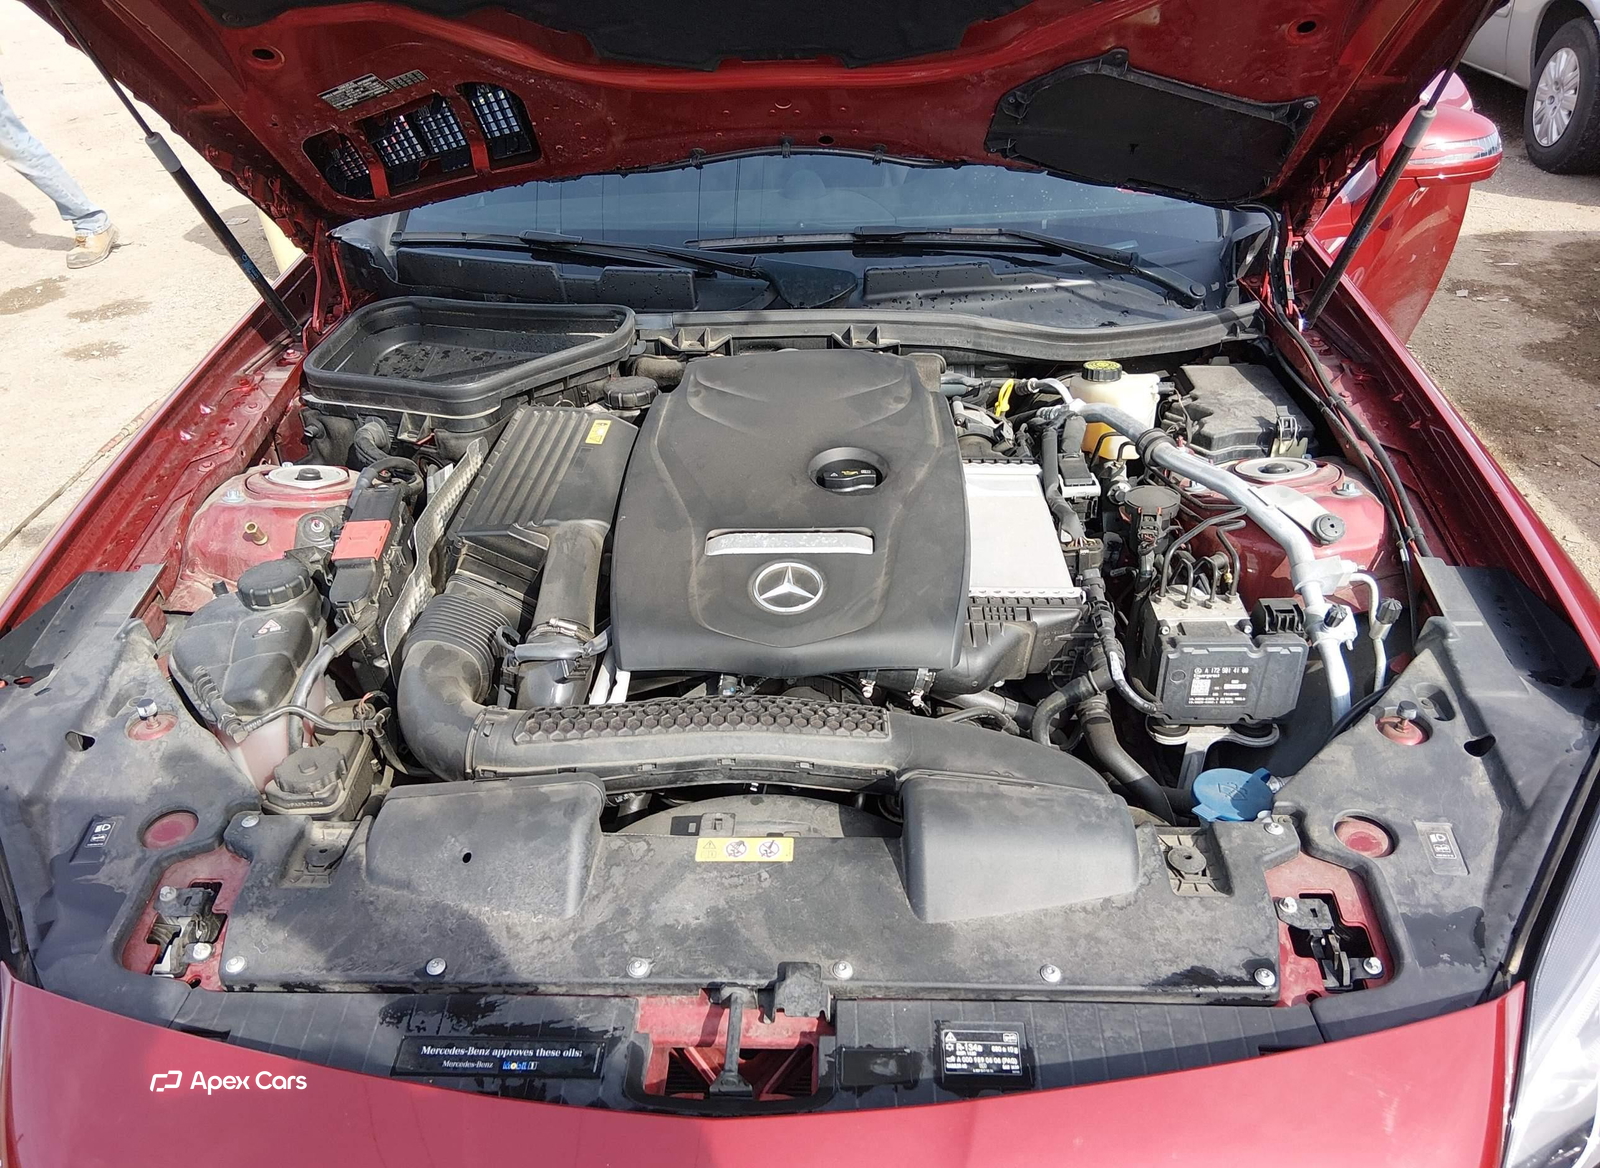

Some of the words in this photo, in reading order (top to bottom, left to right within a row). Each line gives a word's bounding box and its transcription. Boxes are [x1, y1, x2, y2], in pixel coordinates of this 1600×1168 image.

[421, 1046, 490, 1056] Mercedes-Benz
[492, 1048, 534, 1058] approves
[536, 1047, 560, 1057] these
[563, 1048, 582, 1057] oils:
[442, 1060, 493, 1068] Mercedes-Benz
